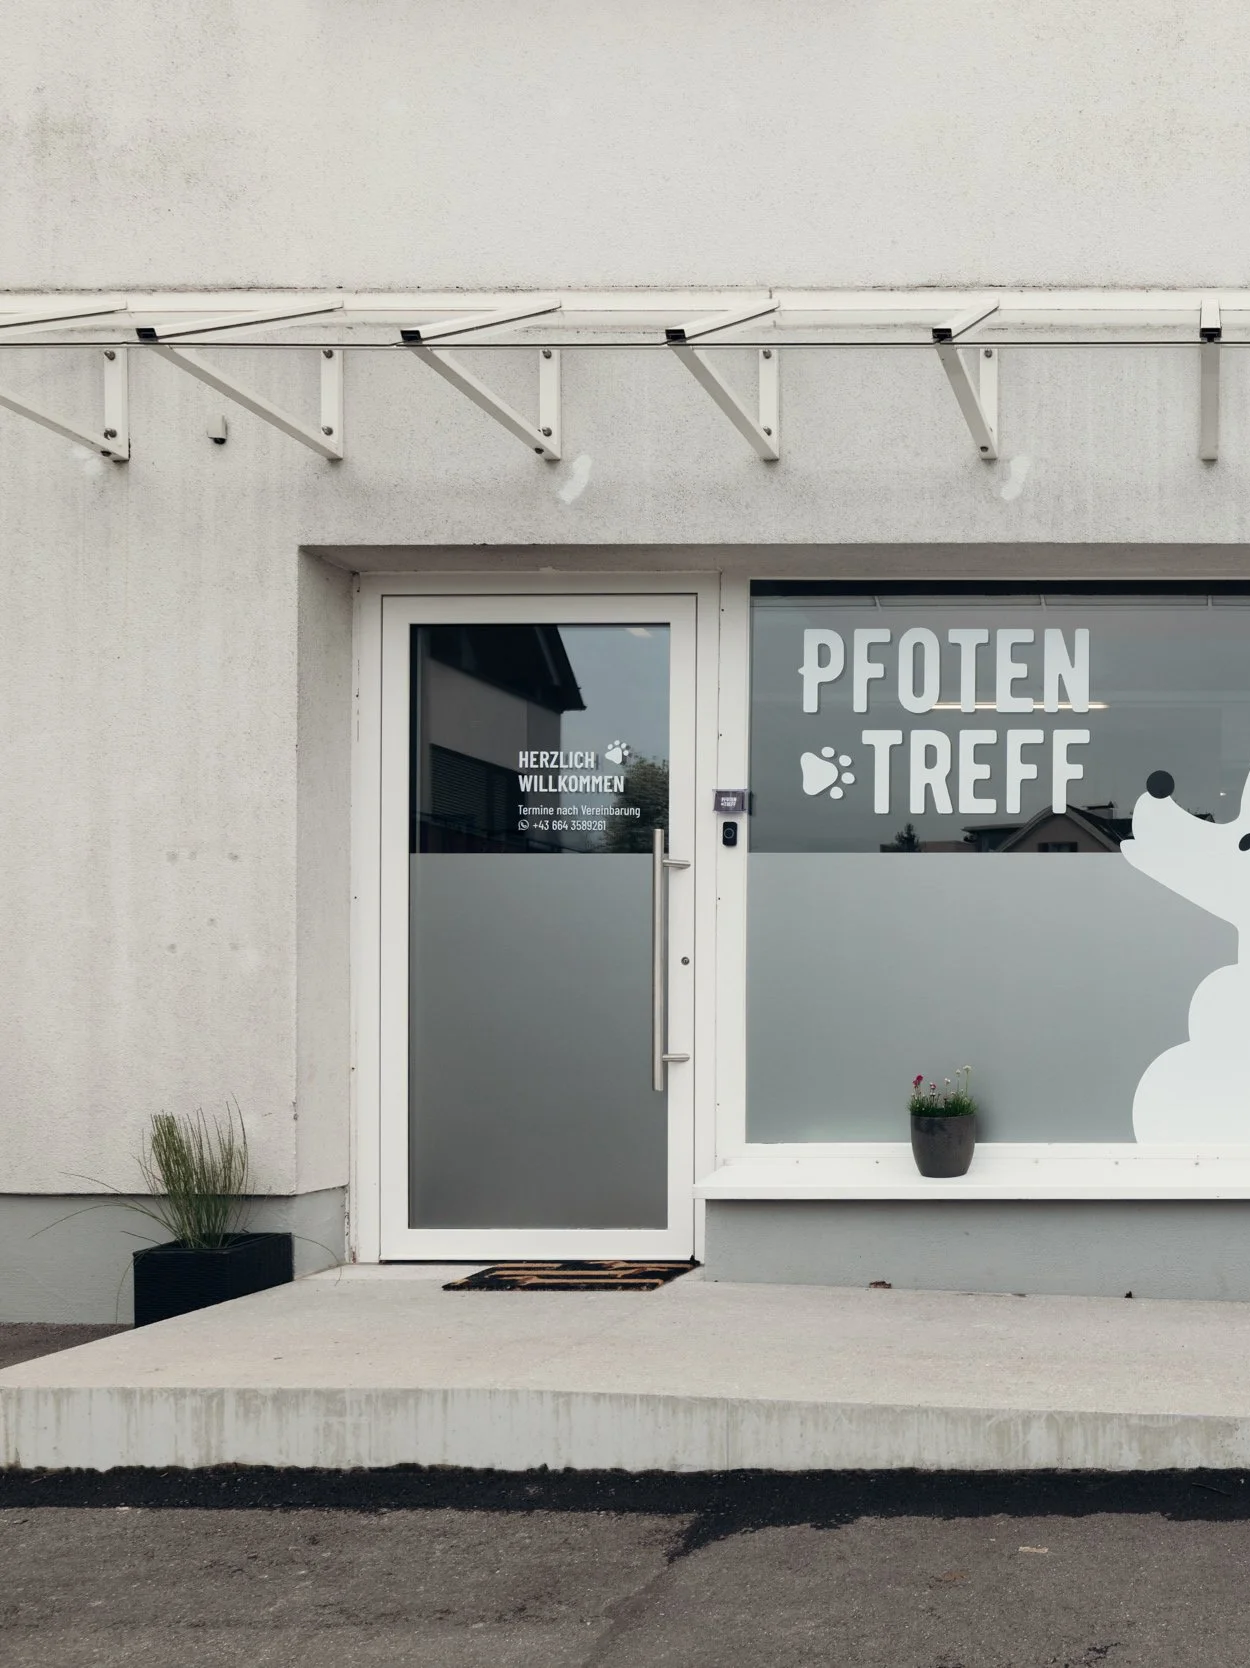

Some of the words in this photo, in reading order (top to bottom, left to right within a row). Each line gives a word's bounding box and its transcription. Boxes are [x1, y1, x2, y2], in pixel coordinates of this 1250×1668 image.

[798, 627, 1090, 714] PFOTEN
[518, 751, 595, 769] HERZLICH
[861, 729, 1090, 814] TREFF
[518, 775, 625, 793] WILLKOMMEN
[518, 804, 555, 816] Termine
[556, 805, 578, 816] nach
[581, 804, 641, 819] Vereinbarung
[532, 820, 550, 831] +43
[552, 820, 569, 831] 664
[570, 820, 606, 831] 3589261
